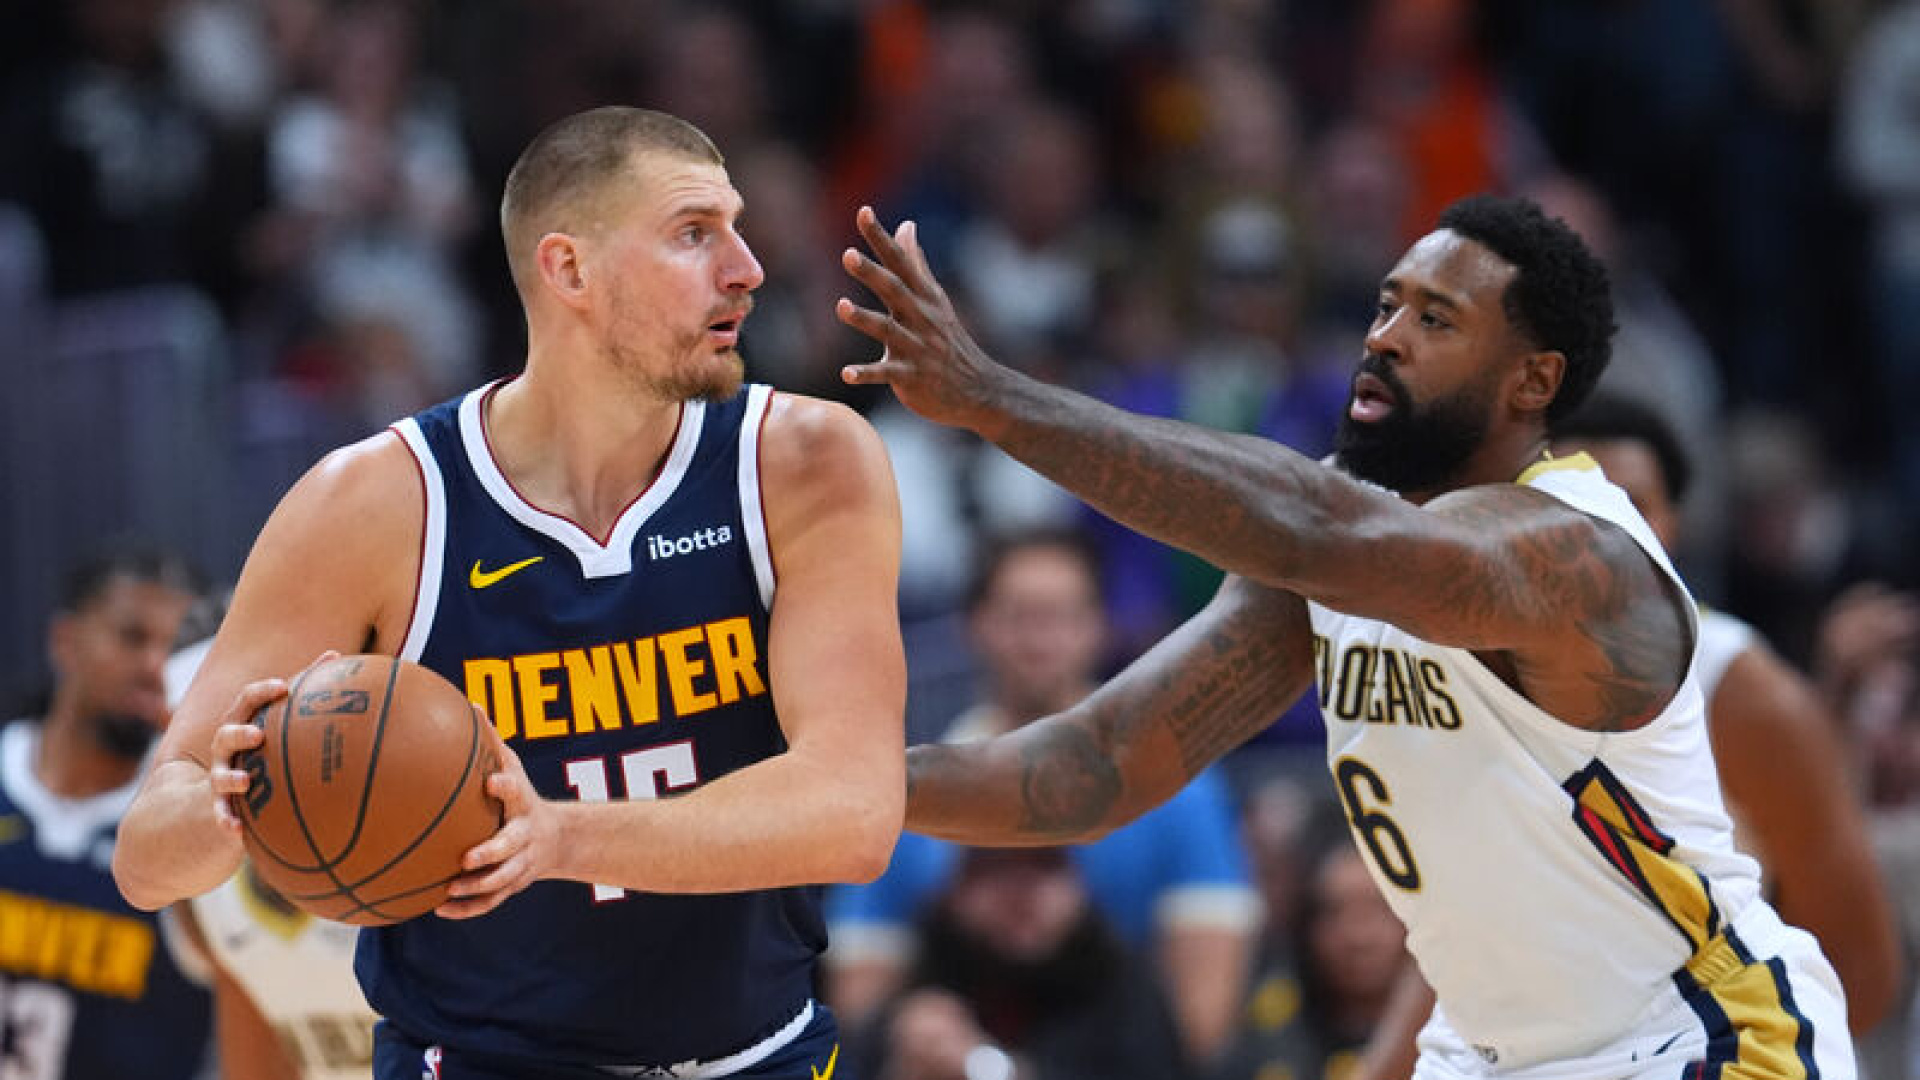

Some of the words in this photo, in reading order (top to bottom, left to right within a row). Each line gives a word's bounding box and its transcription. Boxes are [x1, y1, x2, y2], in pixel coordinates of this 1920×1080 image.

[648, 525, 732, 560] ibotta
[463, 616, 766, 741] DENVER
[1335, 756, 1421, 893] 6
